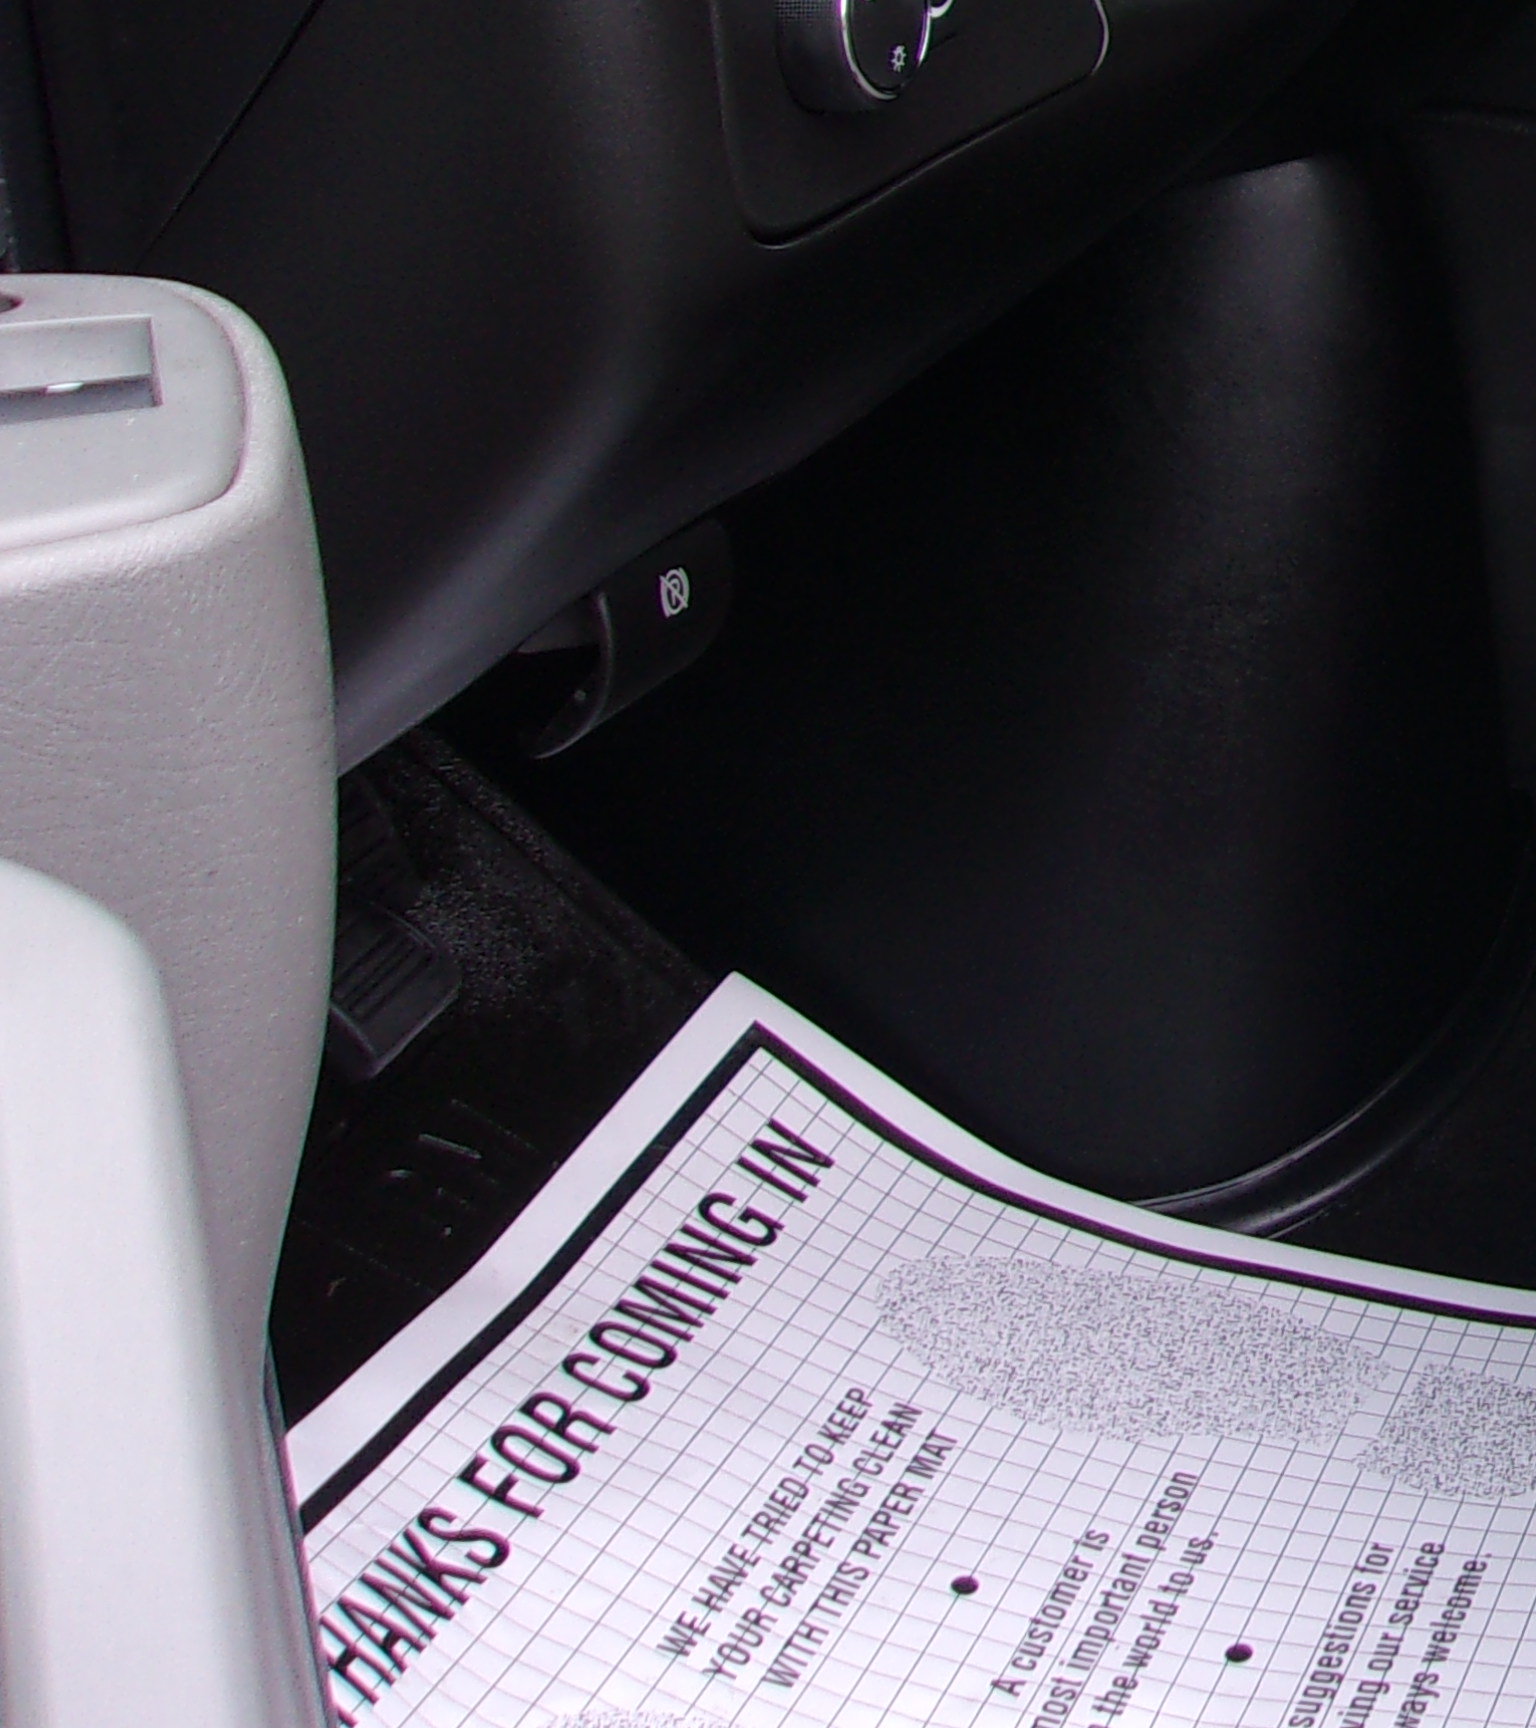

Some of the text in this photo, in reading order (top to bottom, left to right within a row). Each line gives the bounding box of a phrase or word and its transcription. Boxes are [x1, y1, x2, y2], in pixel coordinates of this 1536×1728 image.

[320, 1117, 835, 1728] HANKS FOR COMING IN
[656, 1386, 874, 1658] WE HAVE TRIED TO KEEP
[702, 1401, 924, 1681] YOUR CARPETING CLEAN
[761, 1427, 959, 1689] WITH THIS PAPER MAT
[990, 1529, 1110, 1698] A customer is
[1059, 1552, 1151, 1671] important
[1135, 1471, 1198, 1552] person
[1367, 1632, 1404, 1672] our
[1388, 1541, 1445, 1626] service
[1421, 1553, 1493, 1664] welcome.
[1091, 1674, 1139, 1716] the
[1122, 1599, 1180, 1668] world
[1157, 1571, 1195, 1595] to
[1180, 1531, 1219, 1565] us.
[1288, 1541, 1395, 1728] suggestions for
